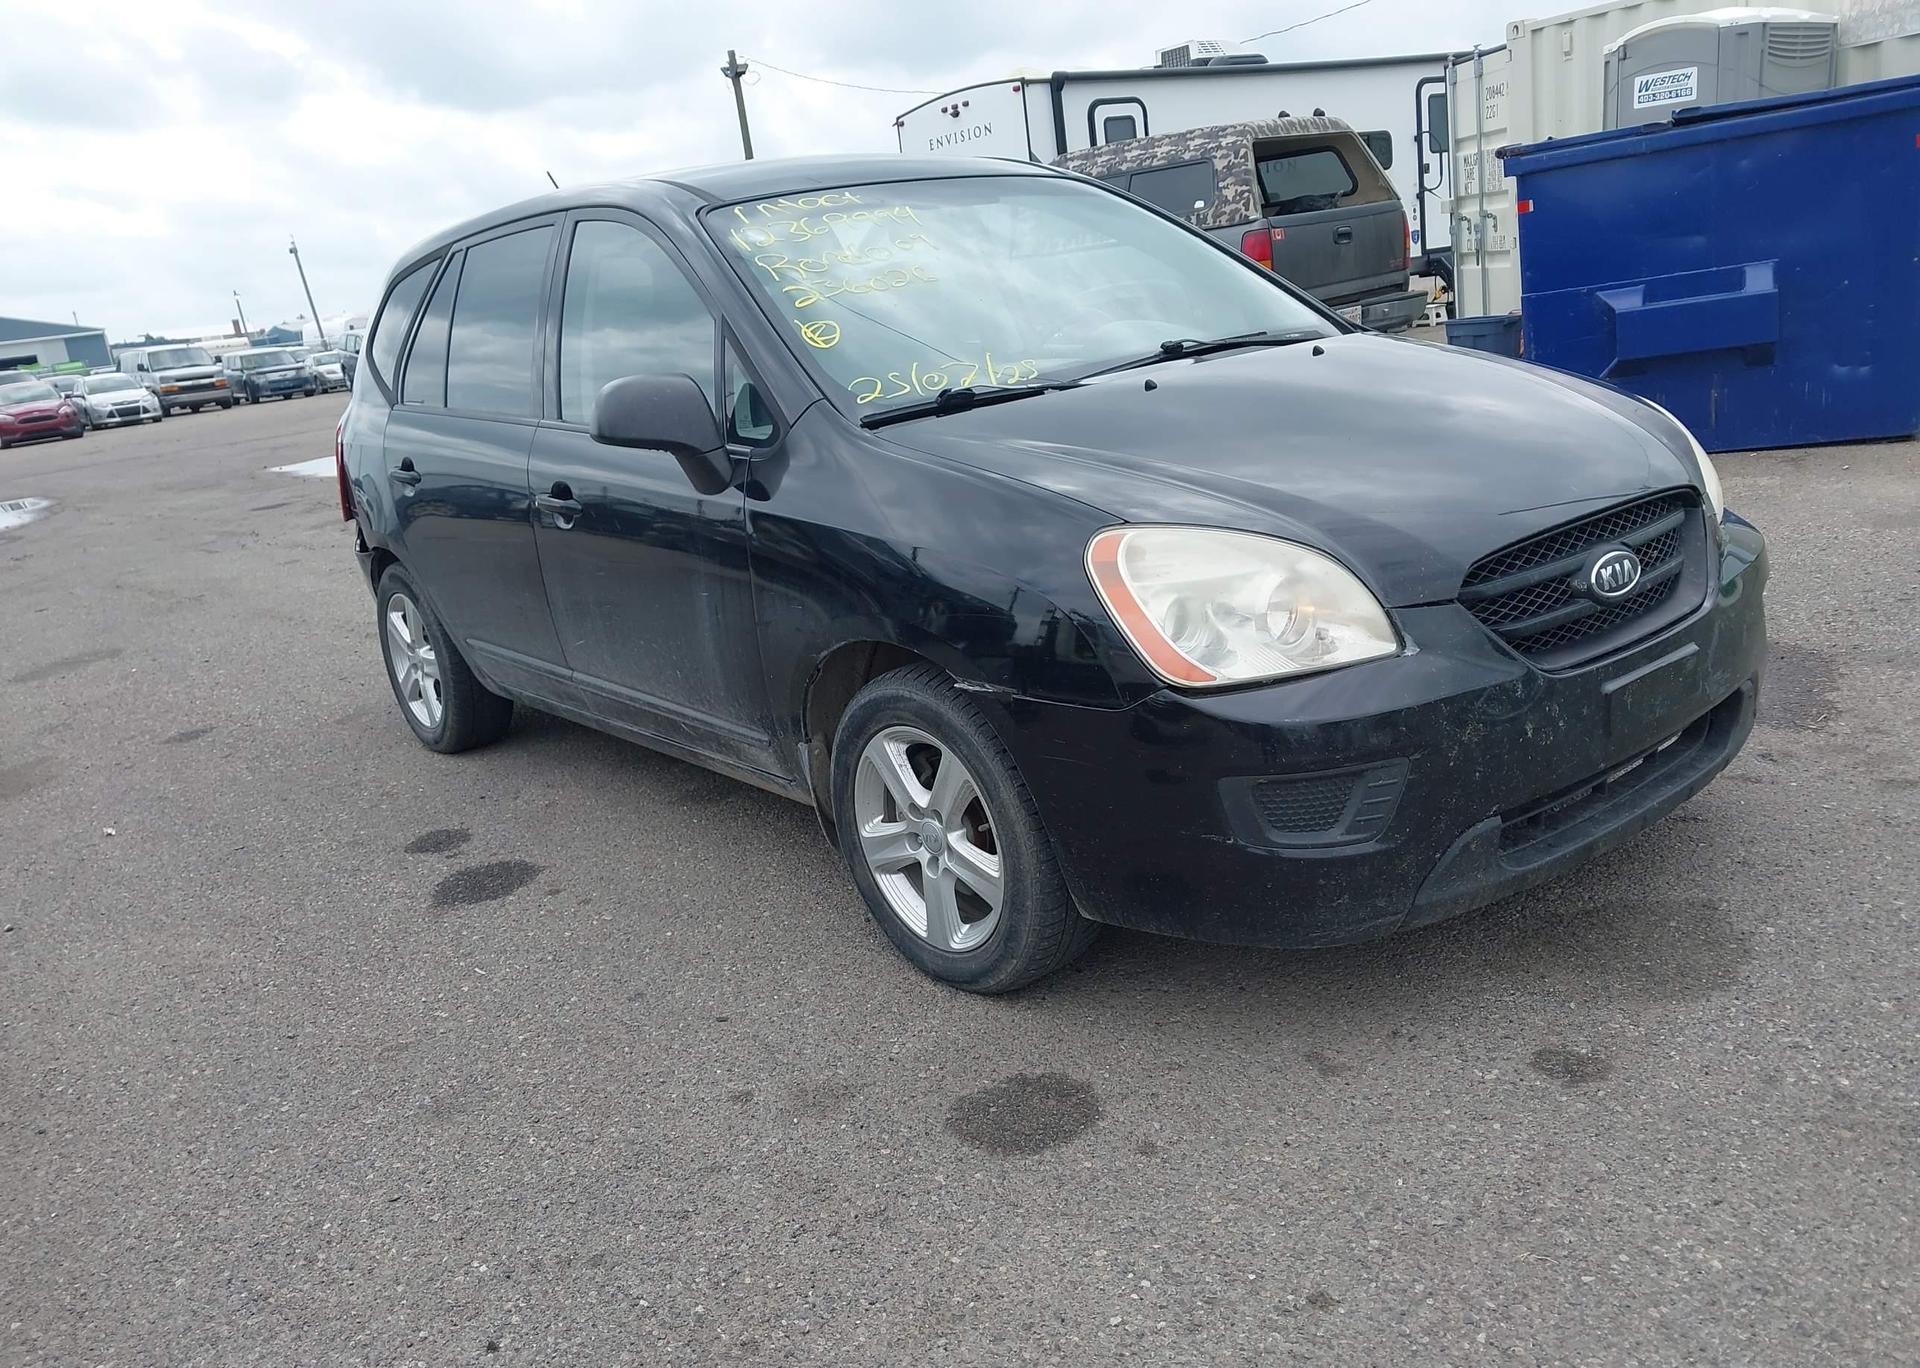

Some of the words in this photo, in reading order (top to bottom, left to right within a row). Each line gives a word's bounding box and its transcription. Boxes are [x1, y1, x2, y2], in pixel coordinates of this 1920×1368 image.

[1638, 72, 1693, 93] WESTECH
[929, 122, 992, 151] ENVISION
[1600, 559, 1636, 590] KIA
